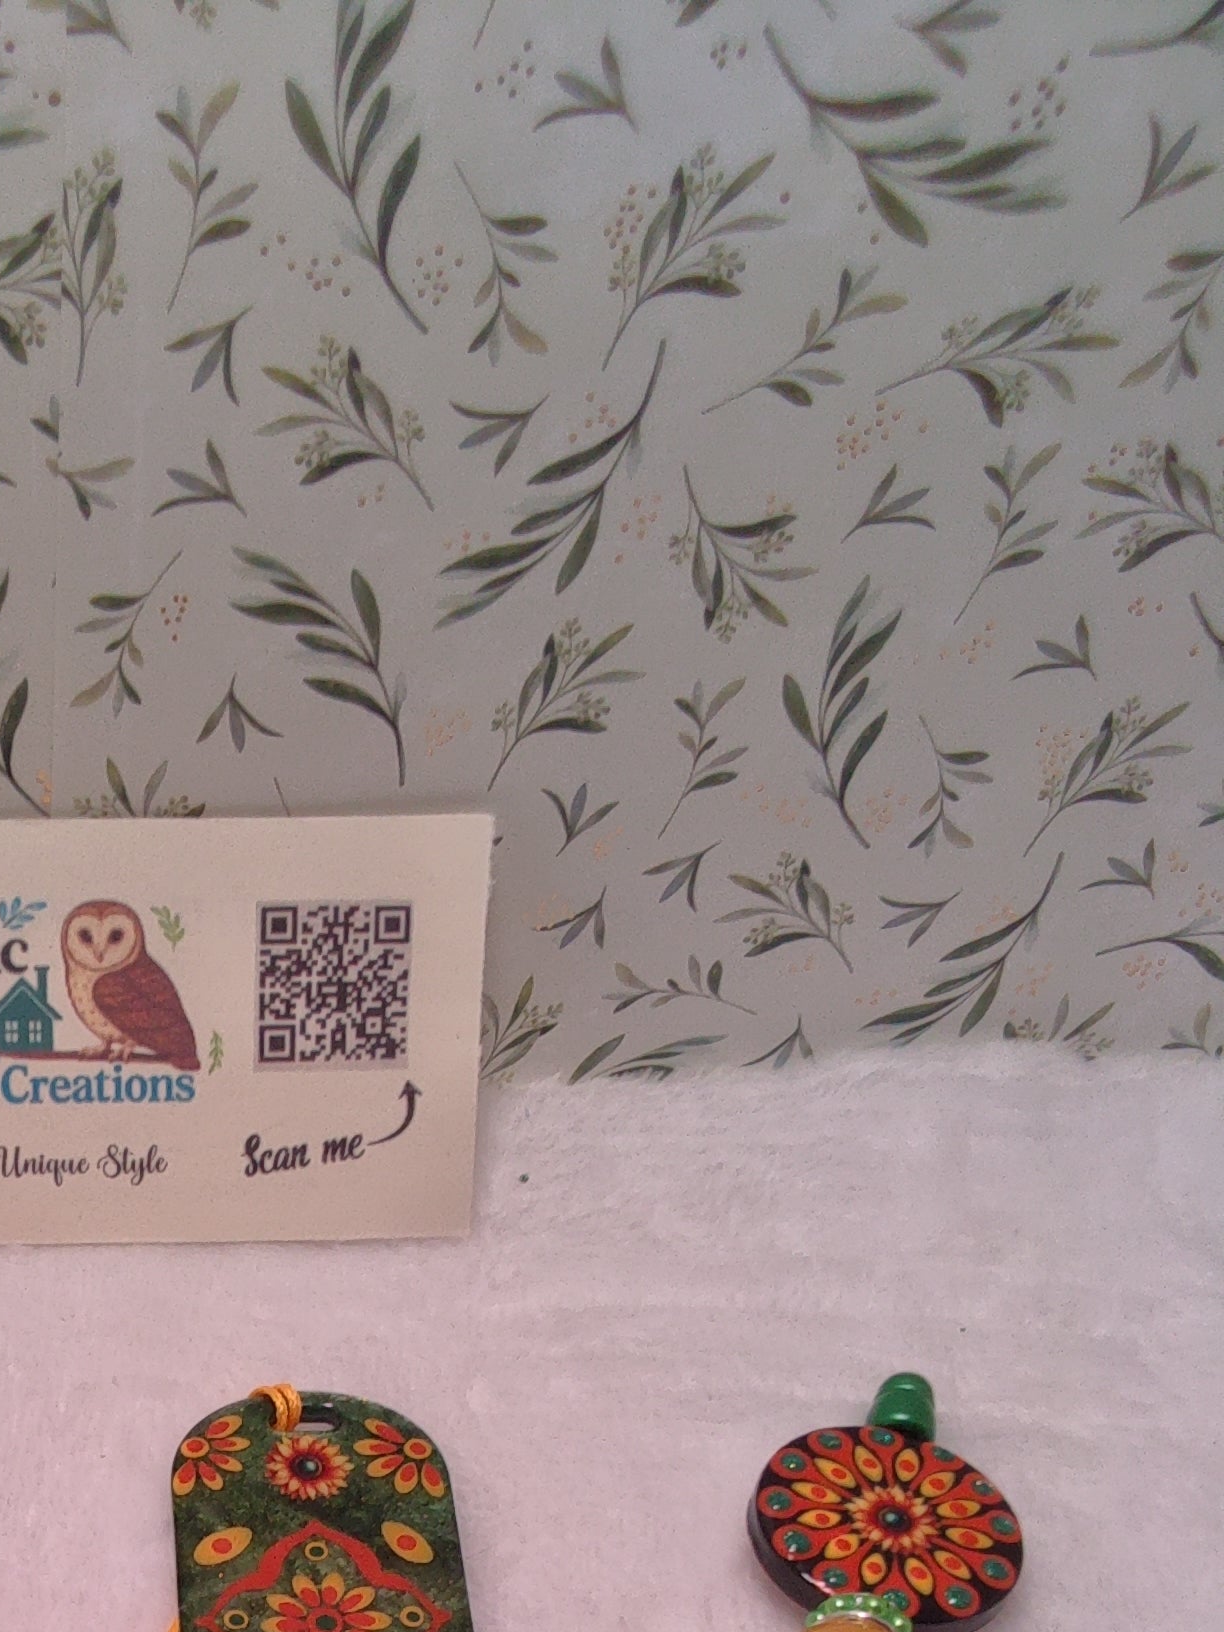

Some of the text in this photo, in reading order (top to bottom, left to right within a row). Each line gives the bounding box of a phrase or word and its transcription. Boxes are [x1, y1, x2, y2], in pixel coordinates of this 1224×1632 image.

[0, 1065, 195, 1104] Creations
[96, 1145, 168, 1186] Style
[242, 1133, 366, 1178] Scan me
